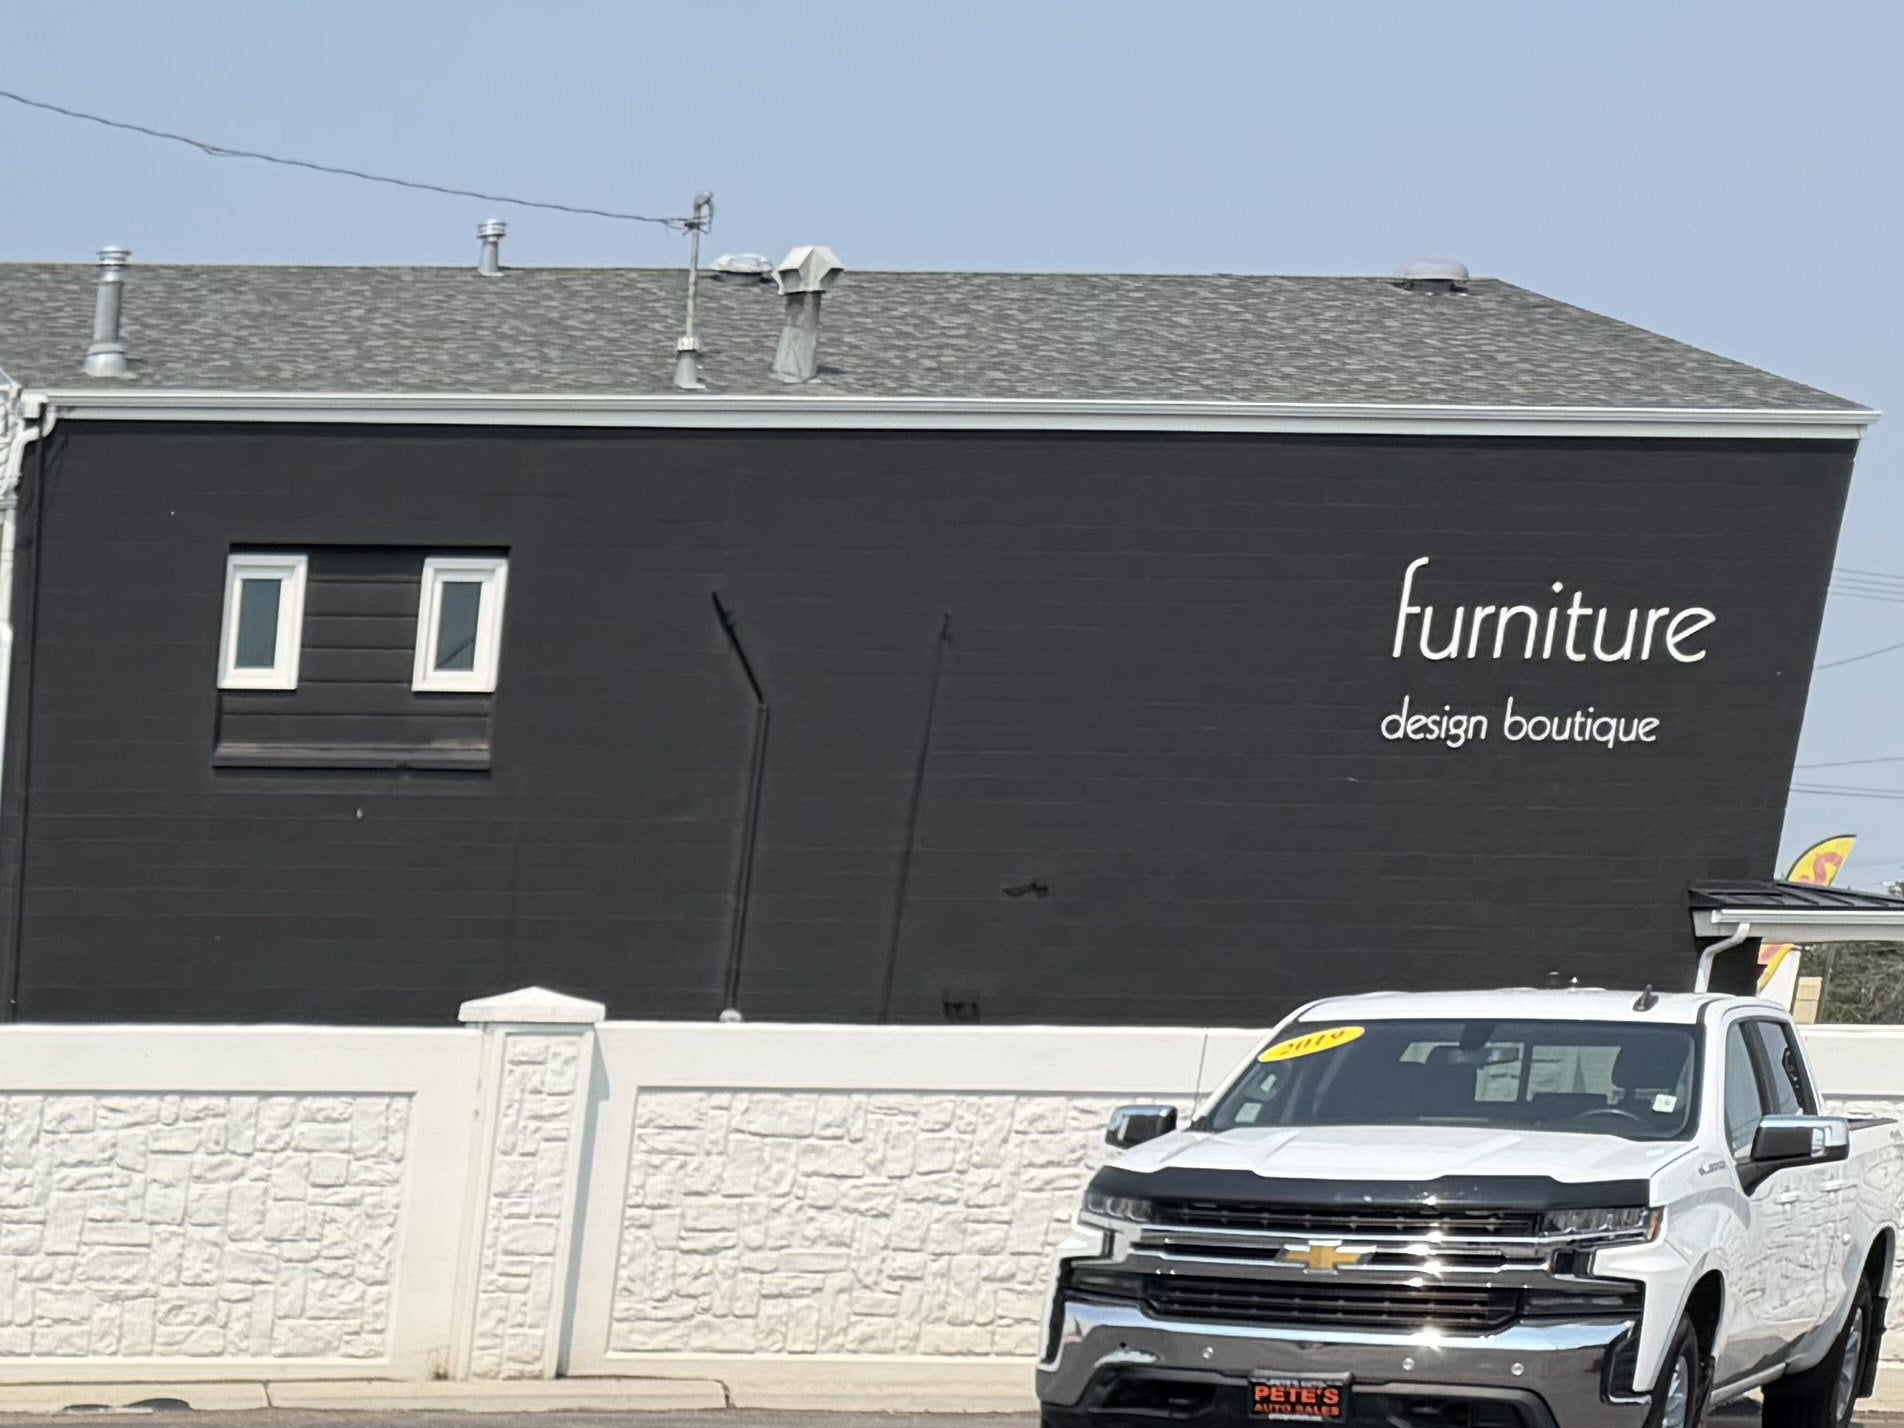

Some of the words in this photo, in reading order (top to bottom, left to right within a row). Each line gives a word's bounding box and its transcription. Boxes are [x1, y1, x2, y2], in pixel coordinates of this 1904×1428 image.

[1392, 556, 1717, 663] furniture
[1380, 694, 1489, 749] design
[1503, 696, 1661, 750] boutique
[1254, 1385, 1340, 1405] PETE'S
[1254, 1402, 1292, 1416] AUTO
